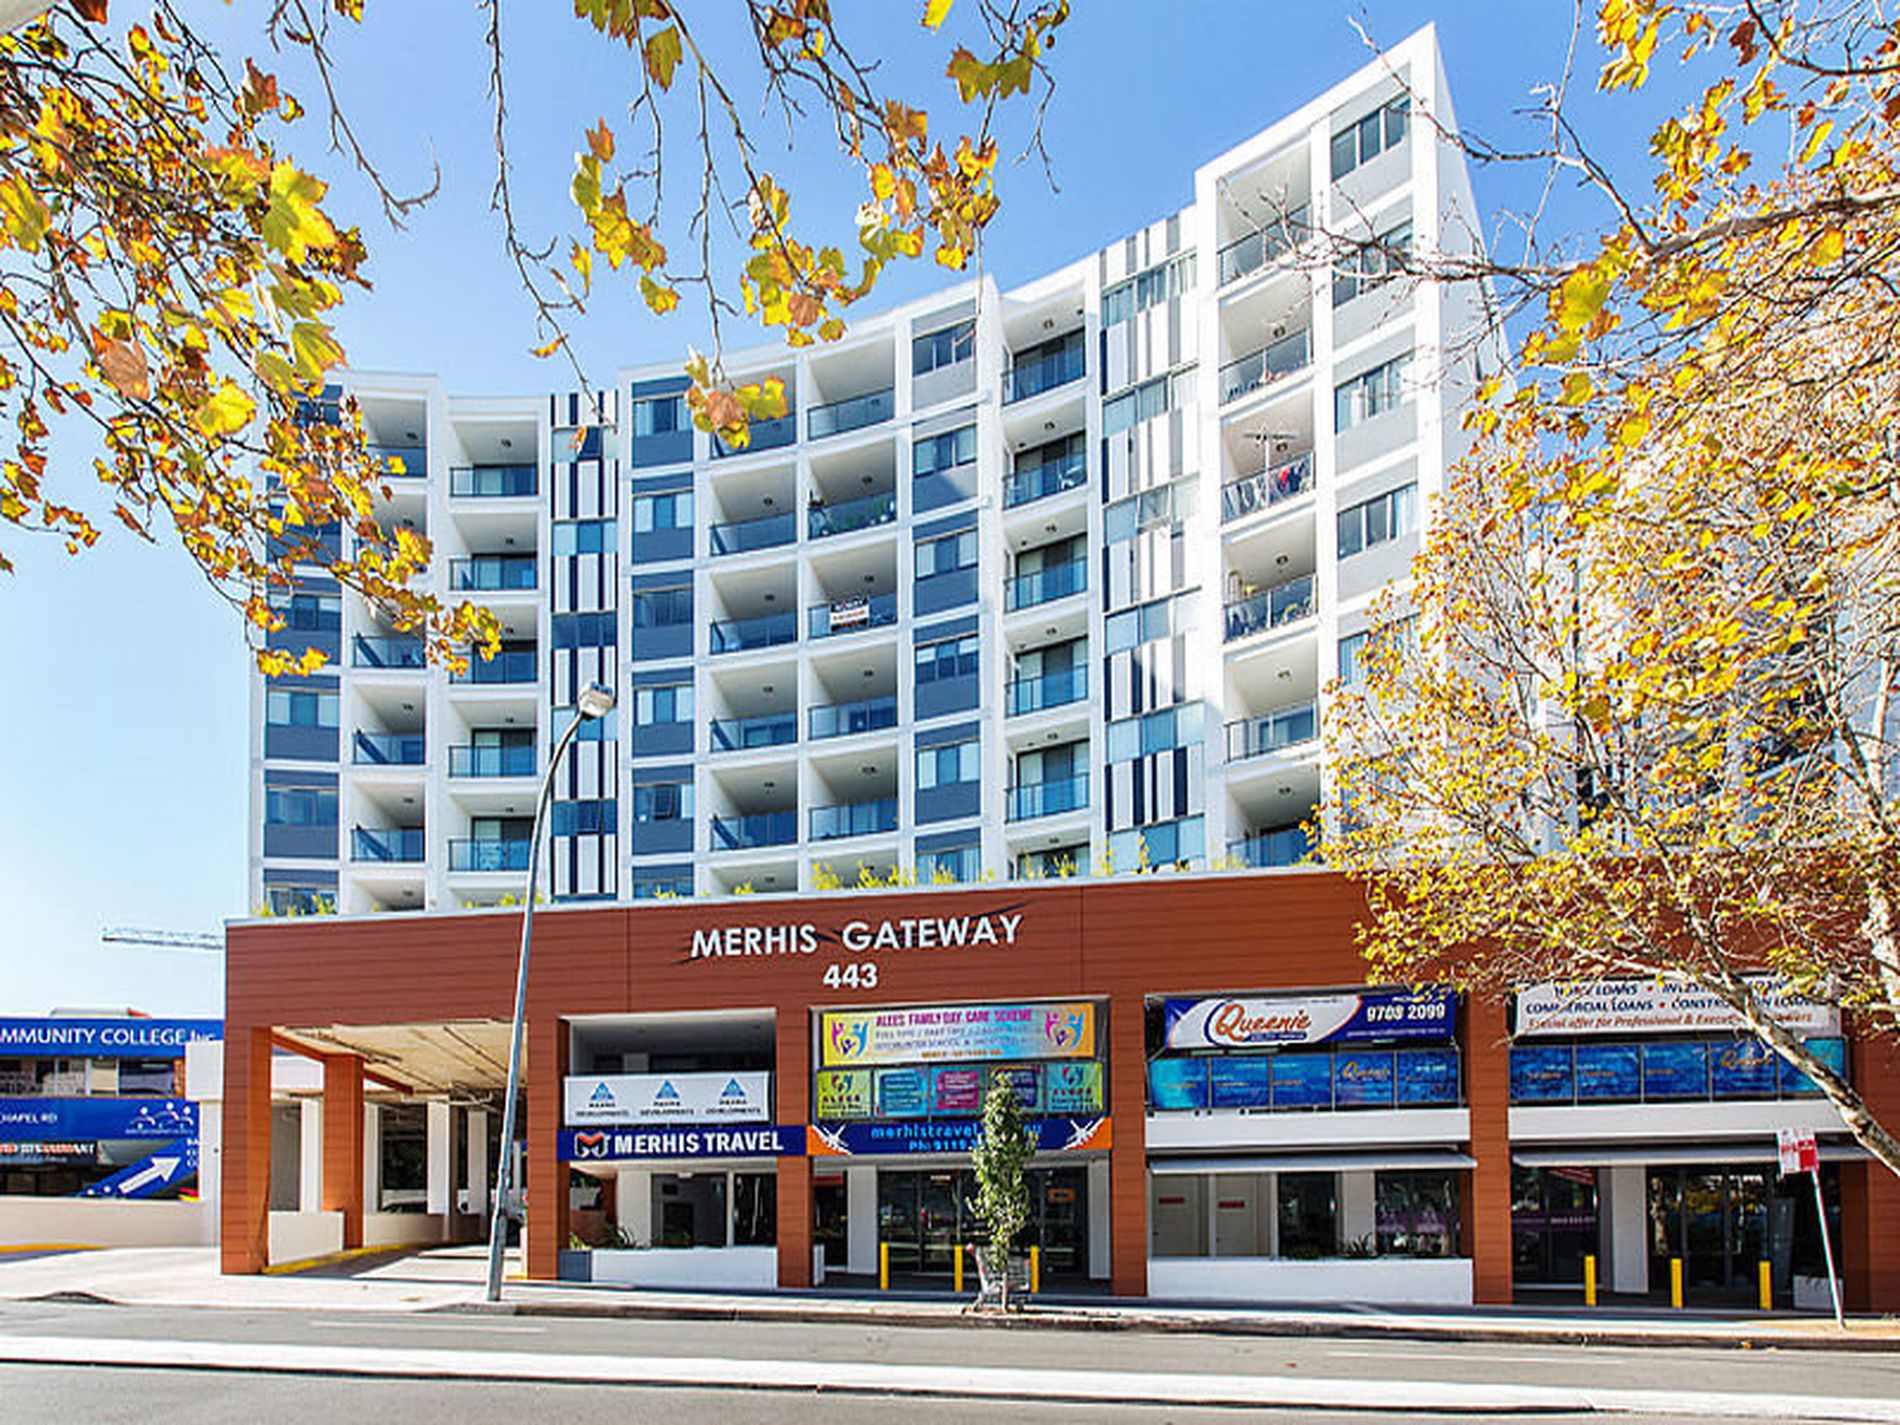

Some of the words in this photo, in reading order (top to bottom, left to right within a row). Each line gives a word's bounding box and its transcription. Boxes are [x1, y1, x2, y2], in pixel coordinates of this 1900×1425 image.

[690, 923, 818, 957] MERHIS
[842, 914, 1022, 951] GATEWAY
[822, 963, 877, 989] 443
[908, 1012, 941, 1026] FAMILY
[965, 1010, 988, 1023] CARE
[994, 1008, 1033, 1022] SCHEME
[1215, 1003, 1313, 1042] Queenie
[1615, 1013, 1682, 1028] Professional
[100, 1027, 186, 1045] COLLEGE
[614, 1134, 699, 1156] MERHIS
[703, 1131, 784, 1153] TRAVEL
